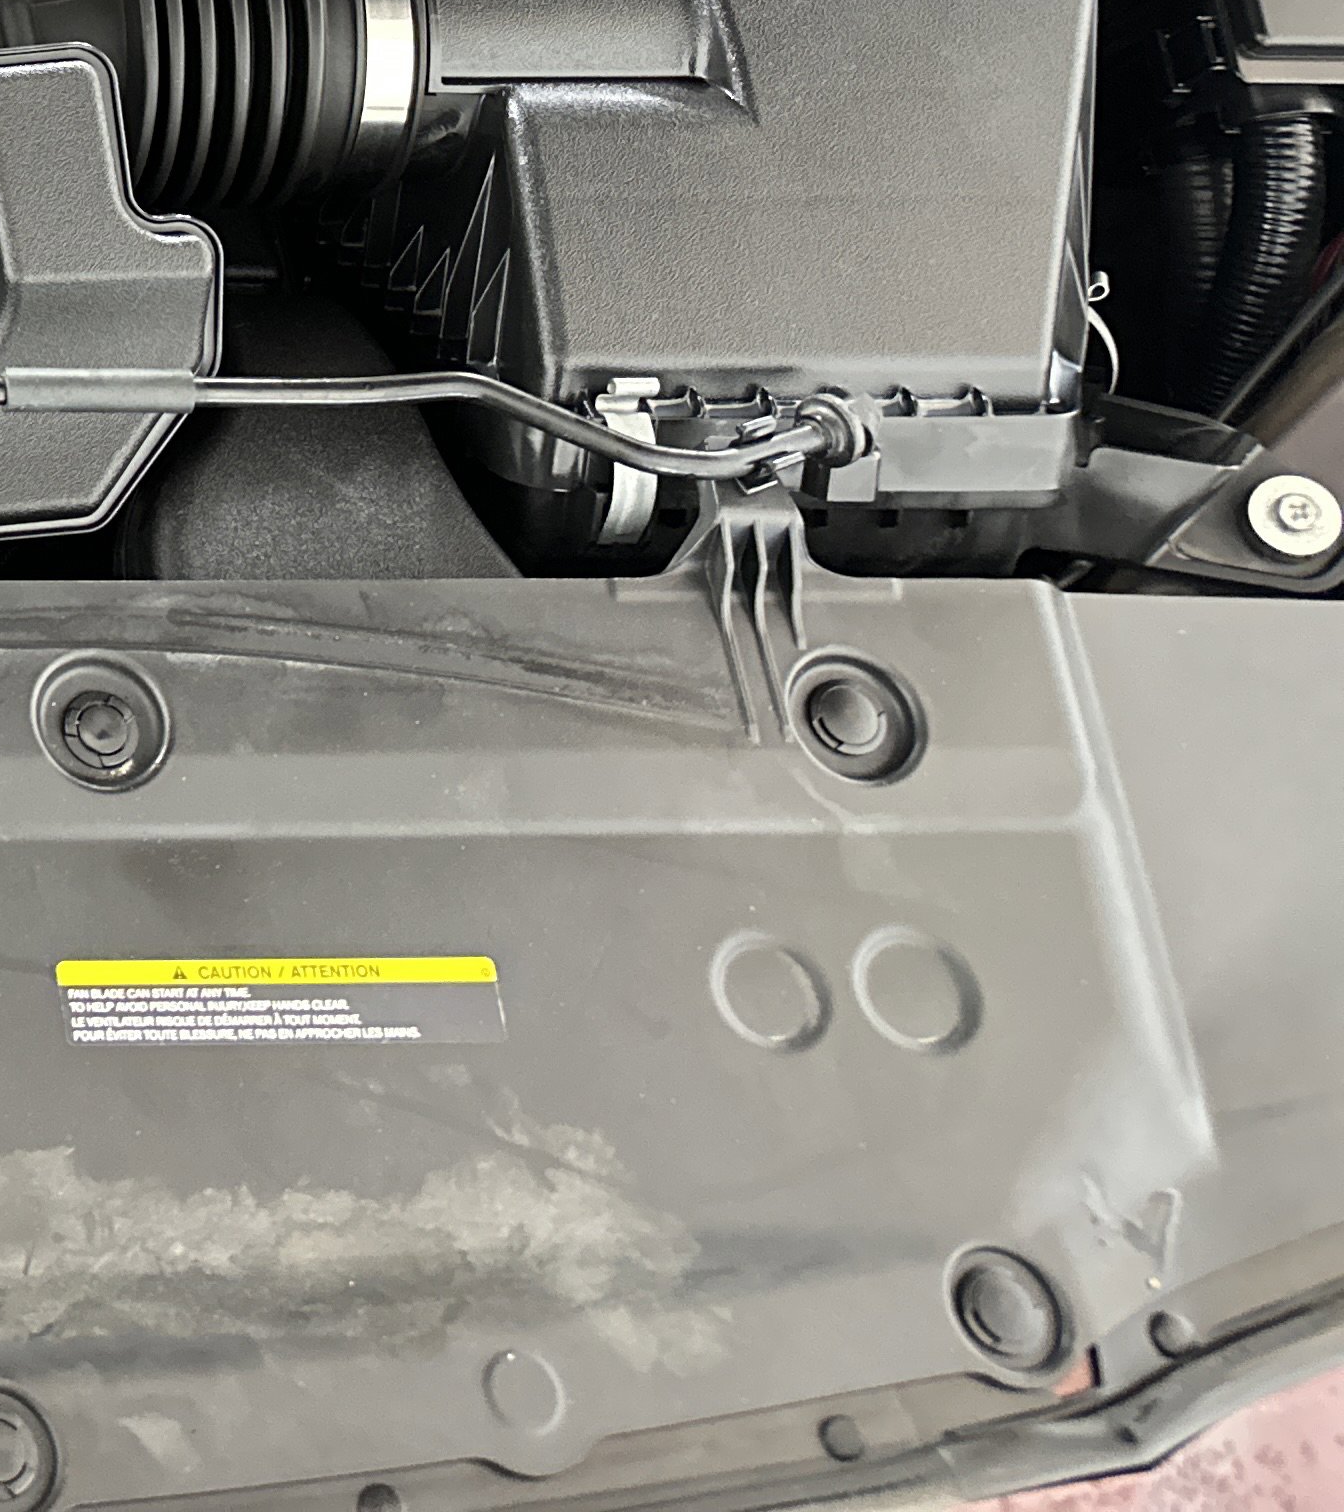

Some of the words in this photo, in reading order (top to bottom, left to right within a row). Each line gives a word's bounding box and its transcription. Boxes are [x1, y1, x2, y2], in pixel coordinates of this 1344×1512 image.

[198, 966, 271, 979] CAUTION
[291, 965, 380, 978] ATTENTION
[68, 988, 89, 999] FAN
[91, 988, 125, 999] BLADE
[127, 988, 150, 998] CAN
[152, 988, 184, 998] START
[185, 988, 199, 998] AT
[201, 988, 223, 998] ANY
[224, 988, 251, 998] TIME.
[70, 1002, 85, 1012] TO
[87, 1001, 113, 1012] HELP
[116, 1001, 148, 1011] AVOID
[150, 1000, 206, 1011] PERSONAL
[272, 1000, 310, 1011] HANDS
[71, 1017, 85, 1027] LE
[86, 1016, 155, 1027] VENTILATEUR
[198, 1016, 213, 1026] DE
[282, 1014, 311, 1025] TOUT
[73, 1030, 105, 1041] POUR
[106, 1027, 142, 1040] ÉVITER
[144, 1030, 178, 1040] TOUTE
[238, 1029, 255, 1039] NE
[256, 1029, 278, 1039] PAS
[279, 1028, 295, 1039] EN
[296, 1027, 362, 1038] APPROCHER
[363, 1027, 383, 1038] LES
